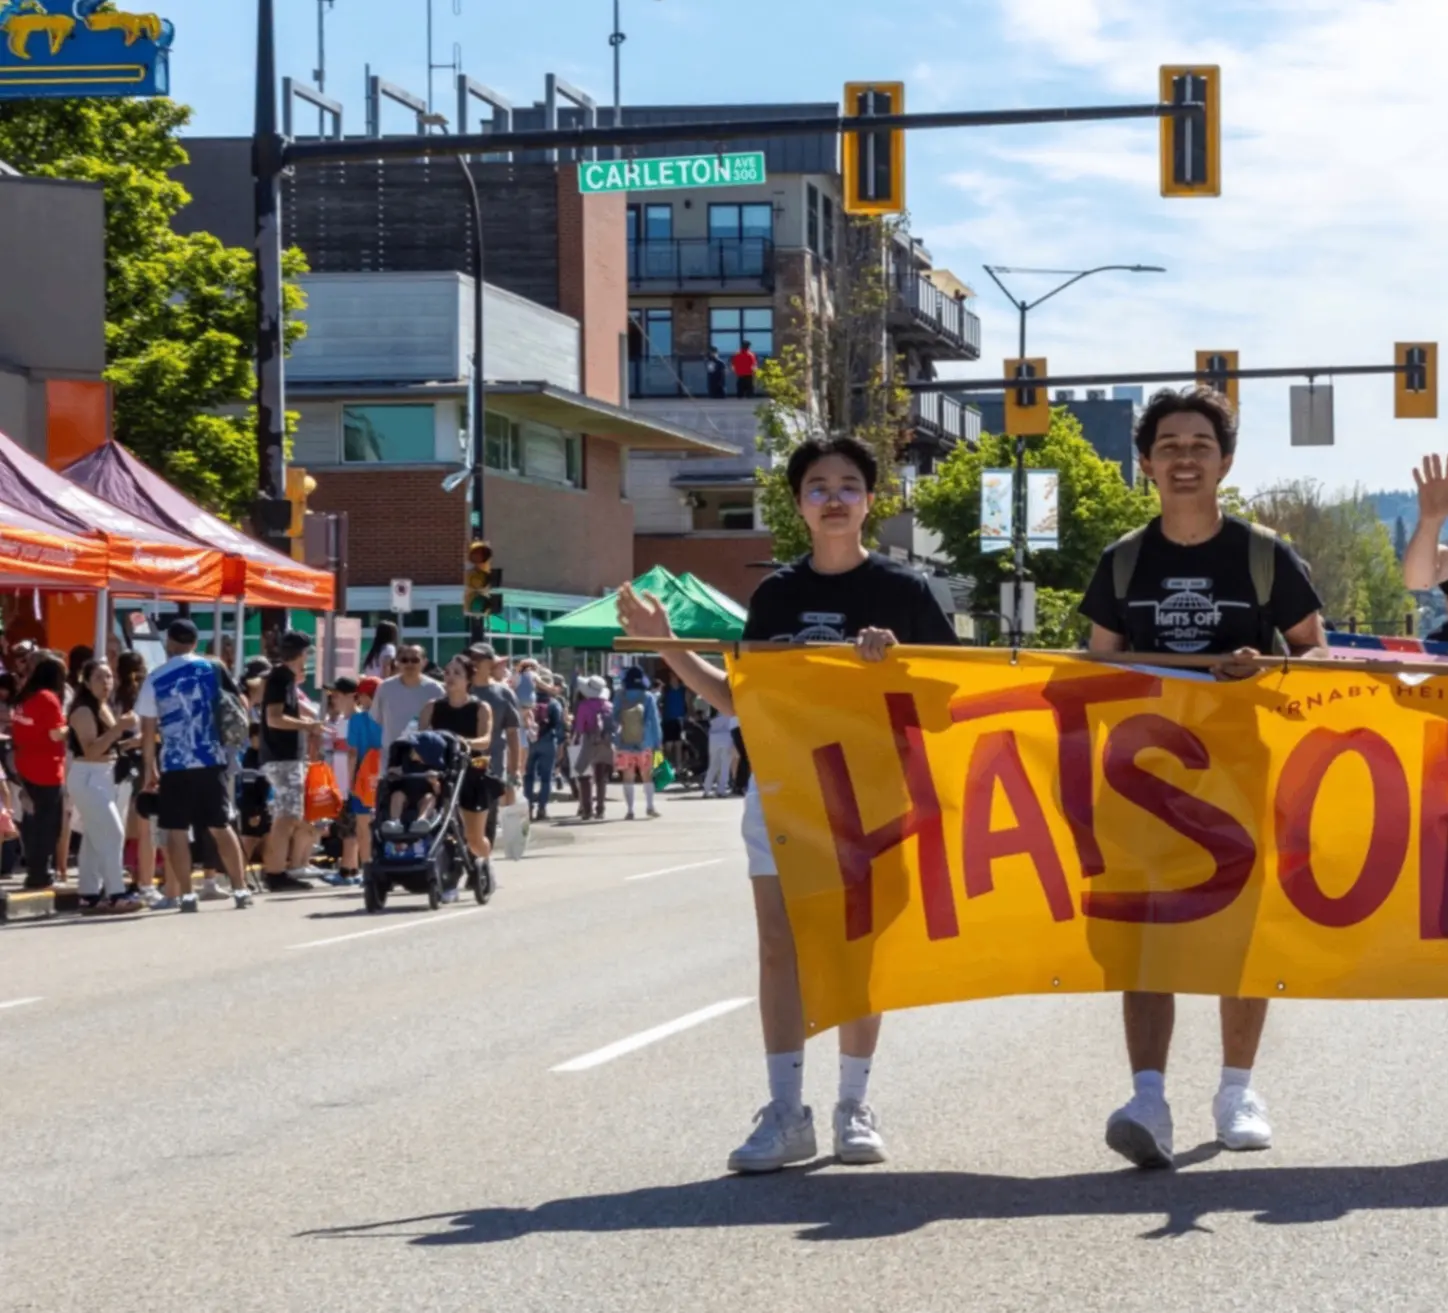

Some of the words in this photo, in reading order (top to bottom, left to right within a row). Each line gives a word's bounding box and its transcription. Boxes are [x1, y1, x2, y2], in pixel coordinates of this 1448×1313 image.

[734, 156, 756, 168] AVE
[585, 158, 731, 190] CARLETON
[733, 169, 757, 181] 300
[1155, 611, 1190, 626] HATS
[1194, 611, 1222, 627] OFF
[812, 671, 1257, 942] HATS
